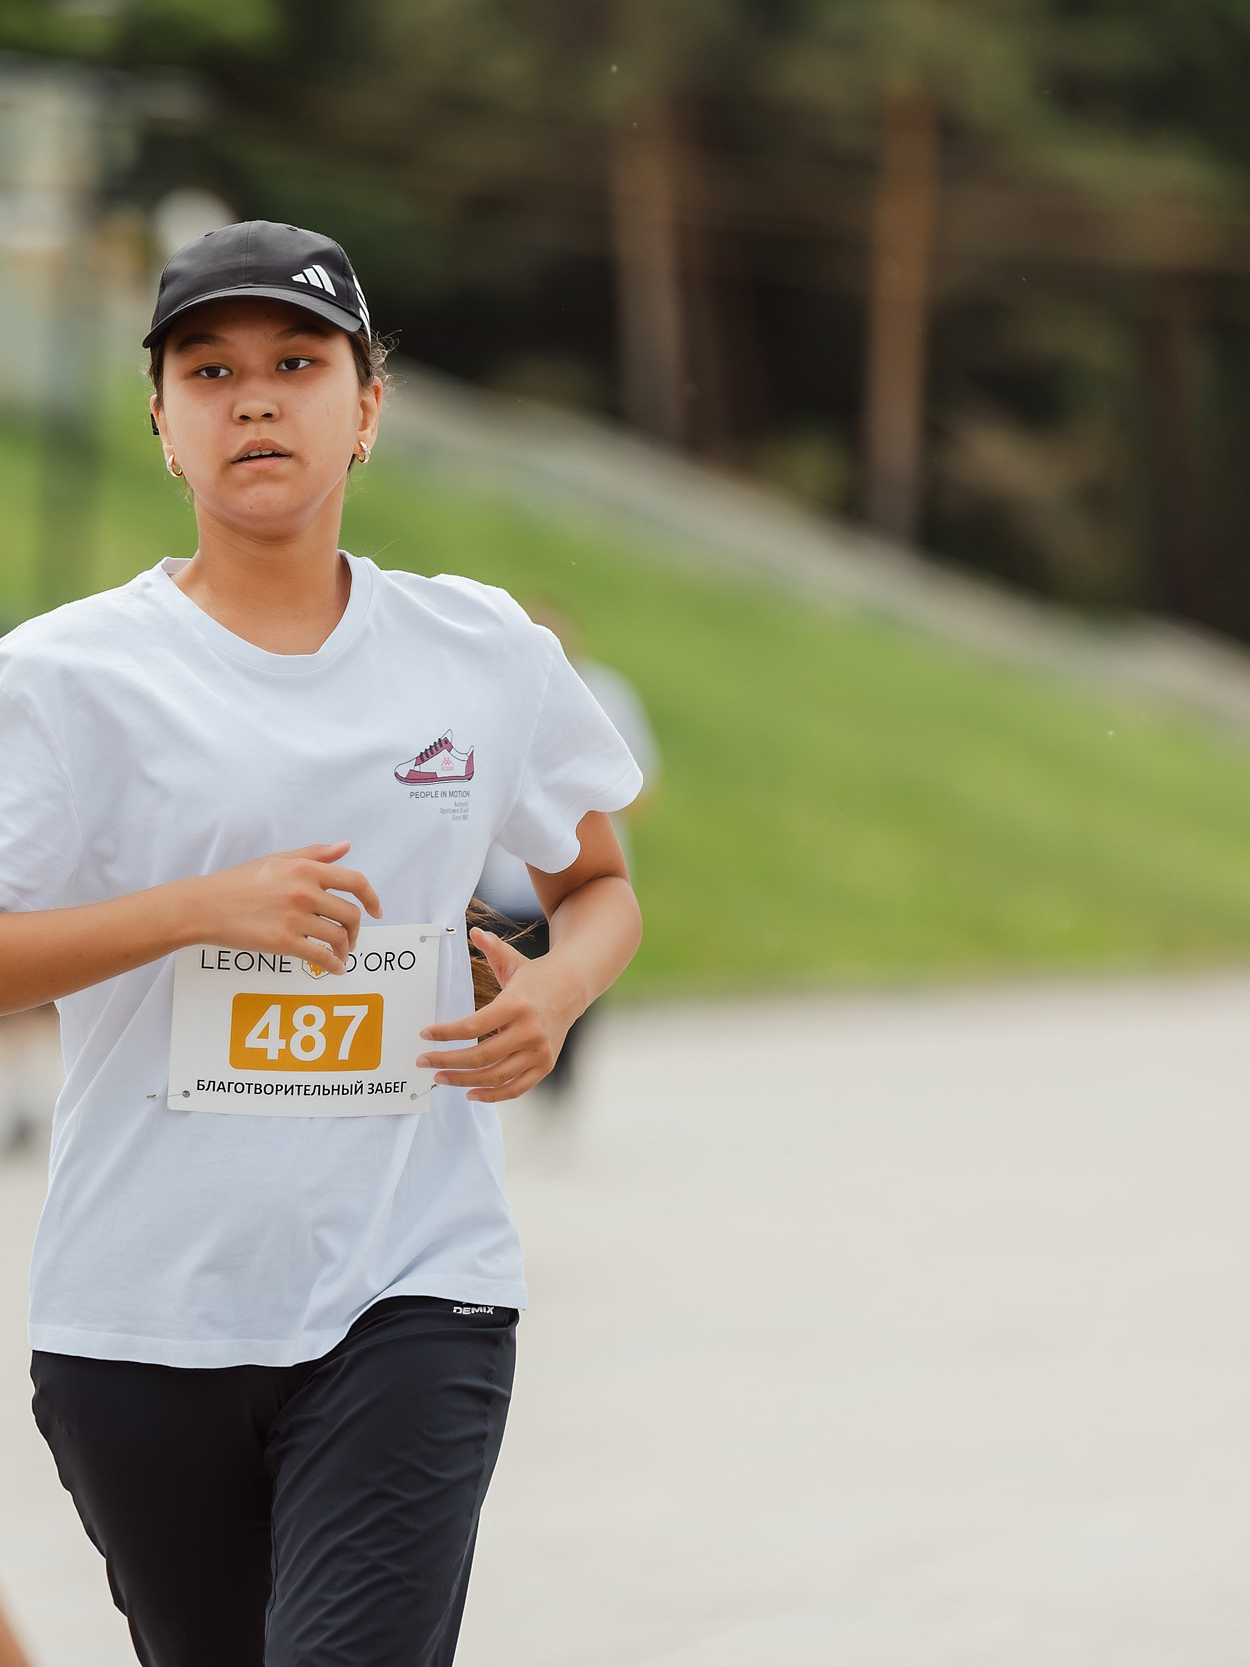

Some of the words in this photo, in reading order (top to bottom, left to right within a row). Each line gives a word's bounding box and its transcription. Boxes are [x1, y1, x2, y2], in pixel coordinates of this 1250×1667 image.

[410, 791, 439, 799] PEOPLE
[449, 790, 470, 798] MOTION
[201, 949, 292, 973] LEONE
[245, 1004, 369, 1062] 487
[196, 1079, 363, 1096] БЛАГОТВОРИТЕЛЬНЫЙ
[367, 1081, 408, 1094] ЗАБЕГ
[453, 1306, 495, 1315] DEMIX
